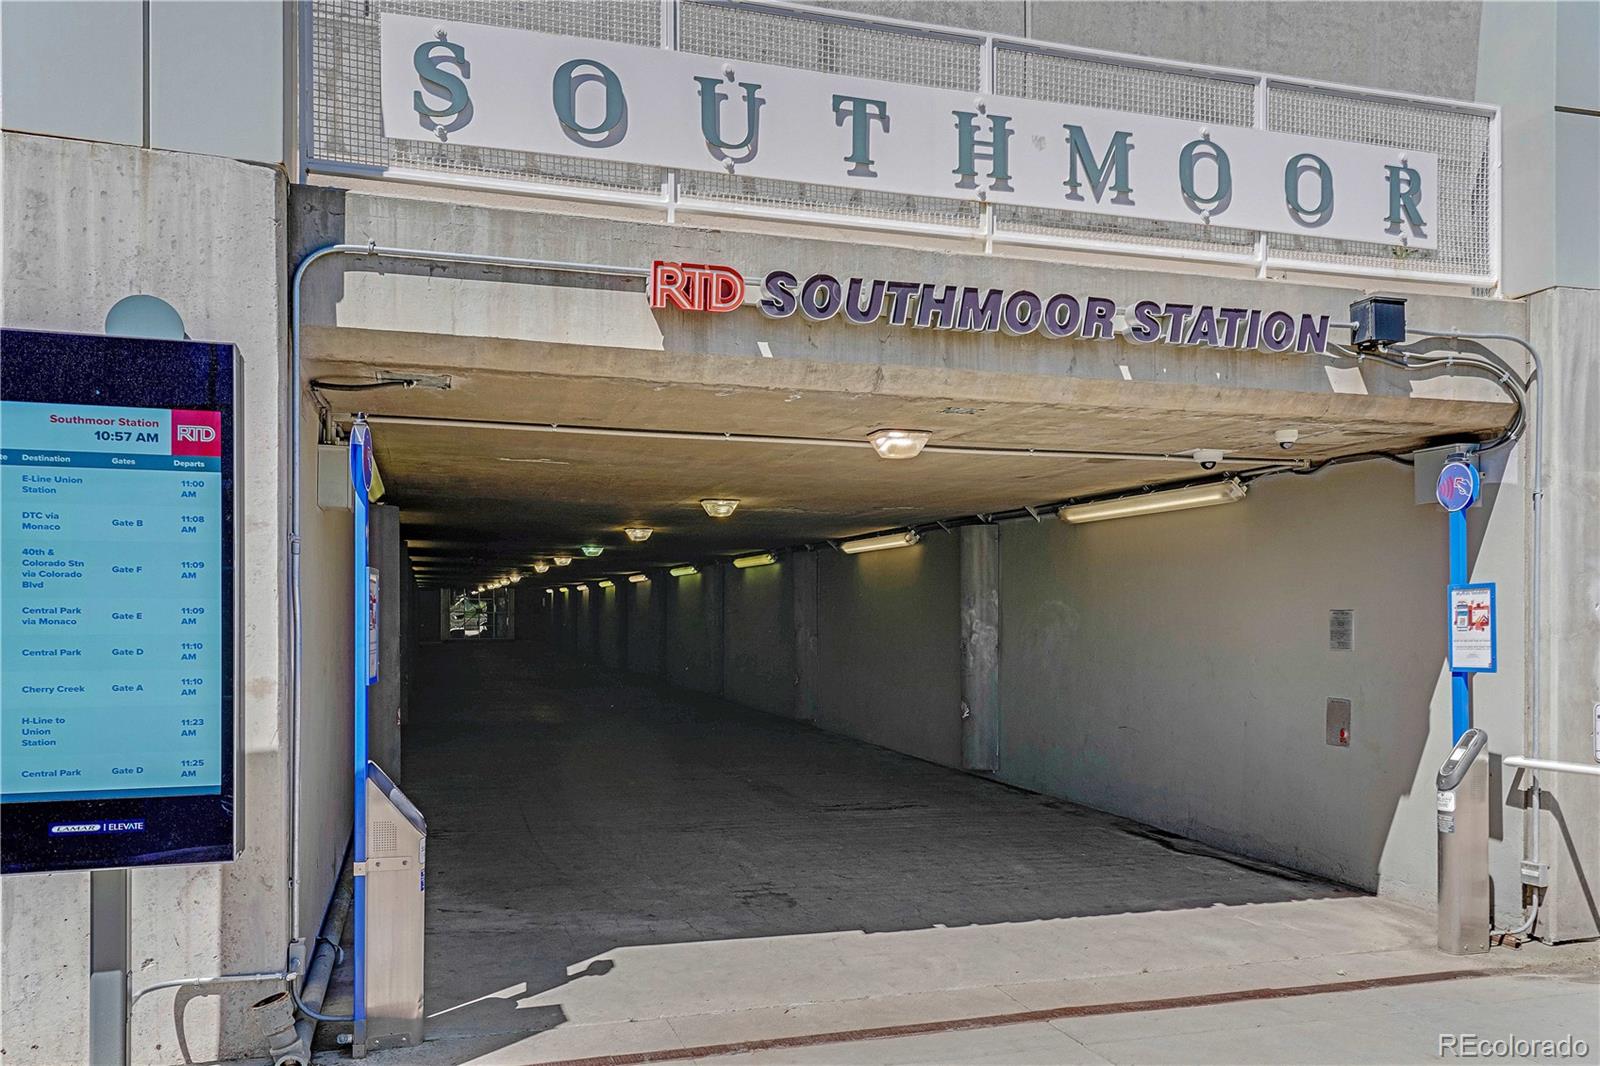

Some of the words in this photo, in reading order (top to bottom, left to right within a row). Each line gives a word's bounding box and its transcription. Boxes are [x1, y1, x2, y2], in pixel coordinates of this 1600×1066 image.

[413, 38, 1427, 230] SOUTHMOOR
[650, 260, 745, 313] RTD
[760, 270, 1116, 335] SOUTHMOOR
[1127, 300, 1330, 354] STATION
[50, 414, 115, 426] Southmoor
[118, 417, 160, 428] Station
[94, 430, 132, 442] 10:57
[135, 432, 159, 443] AM
[177, 424, 216, 442] RTD
[21, 453, 71, 463] Destination
[111, 457, 136, 466] Gates
[173, 459, 205, 469] Departs
[21, 474, 52, 483] E-Line
[54, 475, 83, 484] Union
[181, 480, 205, 488] 11:00
[21, 485, 57, 494] Station
[21, 511, 43, 520] DTC
[45, 512, 60, 520] via
[181, 515, 205, 523] 11:08
[21, 522, 61, 531] Monaco
[111, 519, 133, 527] Gate
[136, 519, 144, 527] B
[21, 548, 45, 556] 40th
[47, 548, 55, 556] &
[21, 558, 66, 568] Colorado
[68, 559, 85, 568] Stn
[181, 561, 205, 569] 11:09
[21, 570, 36, 578] via
[38, 570, 83, 579] Colorado
[111, 566, 133, 574] Gate
[21, 580, 44, 589] Blvd
[21, 606, 58, 615] Central
[60, 606, 82, 615] Park
[181, 607, 205, 615] 11:09
[111, 612, 133, 620] Gate
[136, 612, 143, 620] E
[21, 617, 36, 626] via
[38, 617, 78, 626] Monaco
[21, 648, 58, 657] Central
[60, 648, 82, 657] Park
[111, 648, 133, 656] Gate
[136, 648, 144, 656] D
[181, 653, 197, 661] AM
[181, 678, 204, 686] 11:10
[21, 685, 55, 695] Cherry
[57, 685, 86, 693] Creek
[111, 684, 133, 692] Gate
[135, 684, 144, 692] A
[181, 688, 197, 696] AM
[21, 717, 53, 725] H-Line
[55, 717, 66, 725] to
[21, 727, 51, 736] Union
[181, 729, 197, 737] AM
[21, 738, 57, 747] Station
[181, 759, 205, 767] 11:25
[21, 769, 58, 778] Central
[59, 768, 82, 778] Park
[111, 767, 133, 775] Gate
[136, 766, 144, 774] D
[108, 822, 144, 831] ELEVATE
